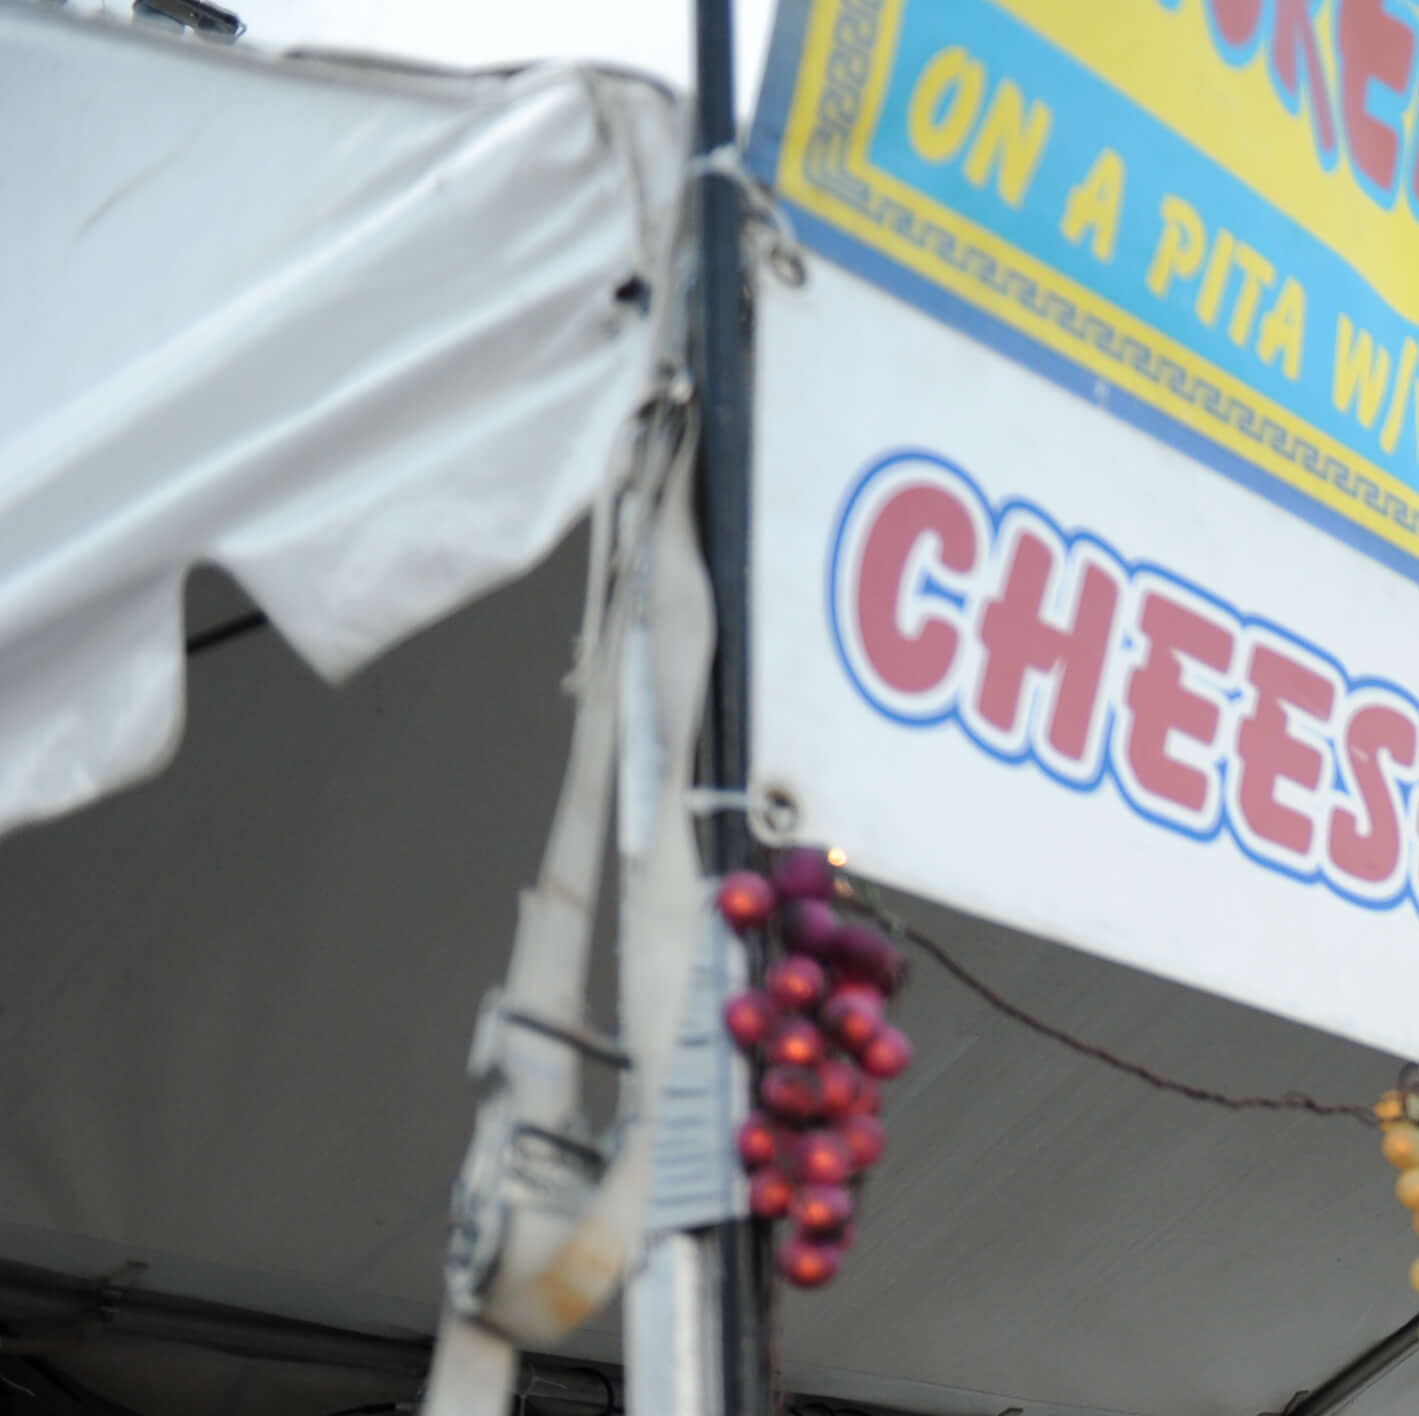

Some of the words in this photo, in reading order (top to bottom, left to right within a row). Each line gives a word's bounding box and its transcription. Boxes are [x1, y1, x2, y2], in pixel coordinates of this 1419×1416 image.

[906, 44, 1053, 211] ON
[1059, 147, 1127, 264] A
[1144, 194, 1309, 382] PITA
